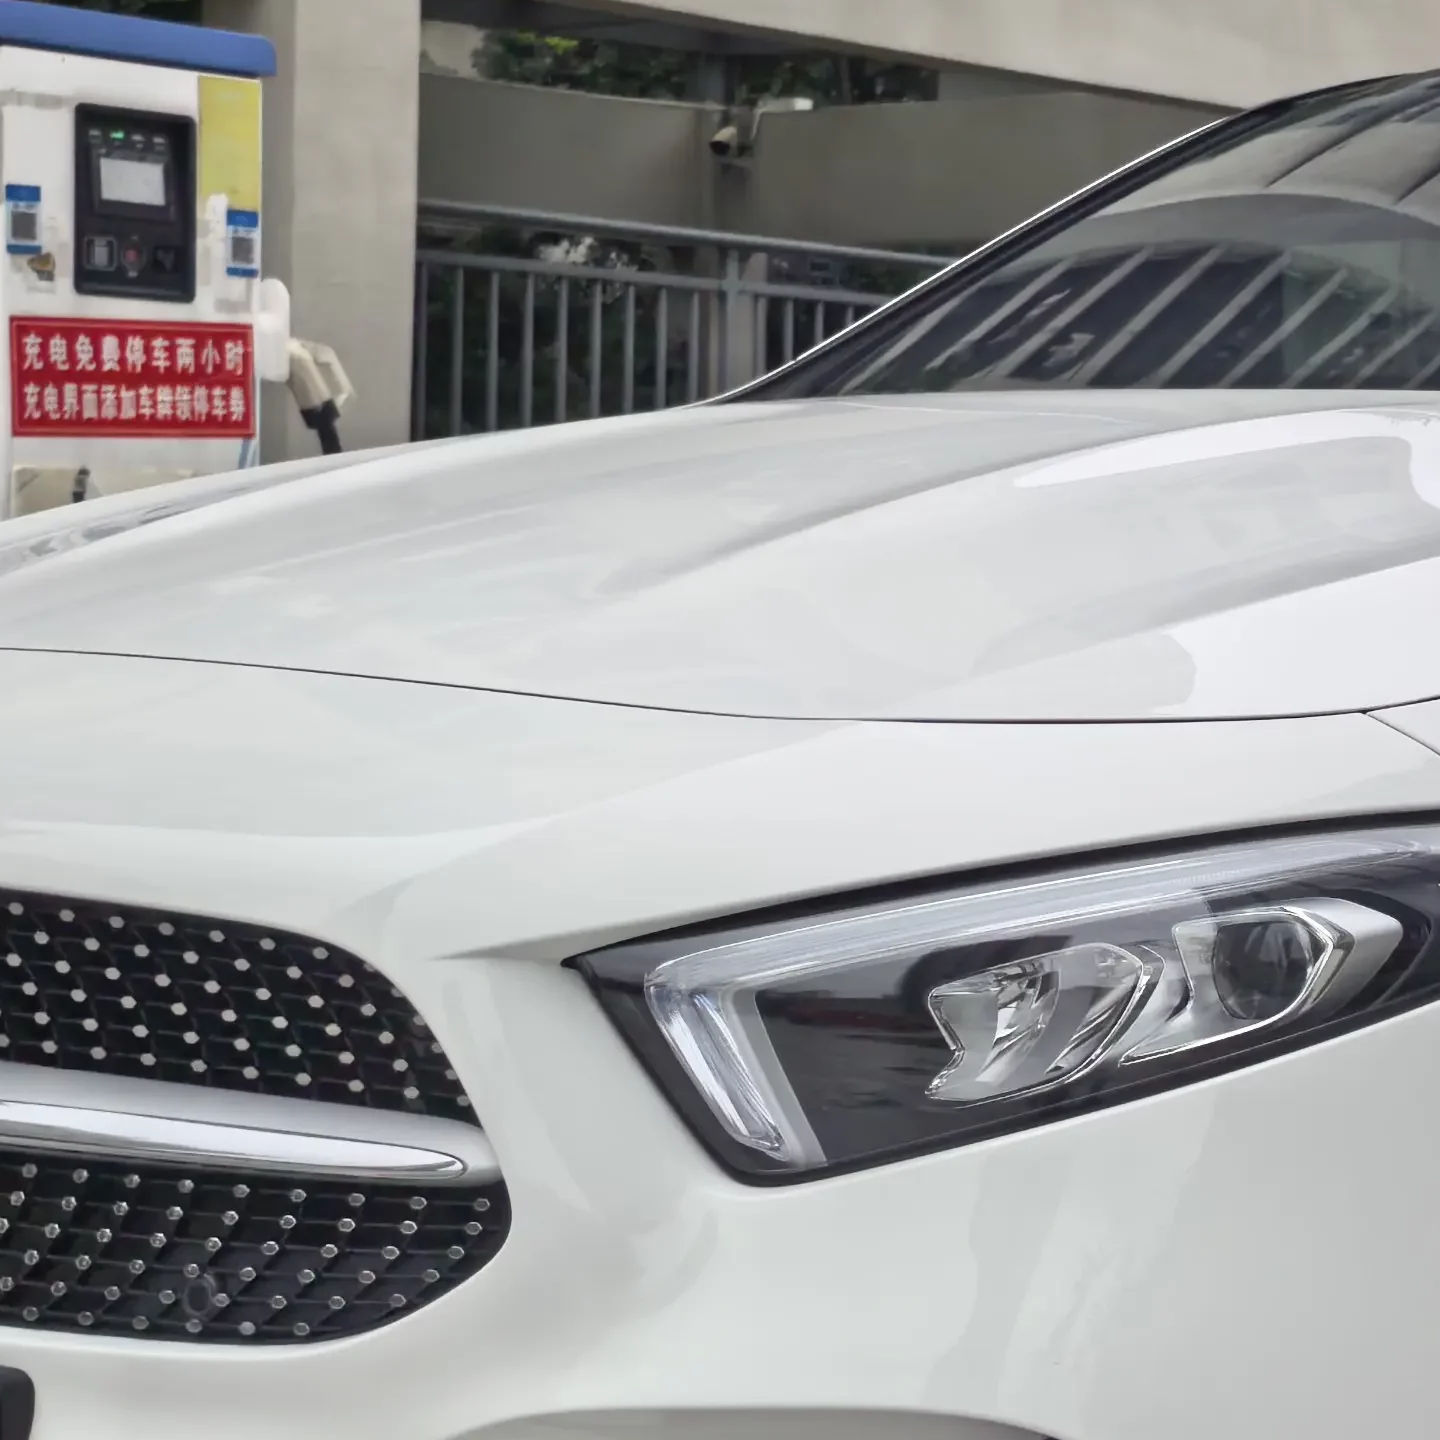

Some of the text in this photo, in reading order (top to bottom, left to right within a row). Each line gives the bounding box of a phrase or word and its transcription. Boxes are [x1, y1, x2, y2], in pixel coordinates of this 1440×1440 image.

[22, 330, 244, 376] 充电免费停车两小时
